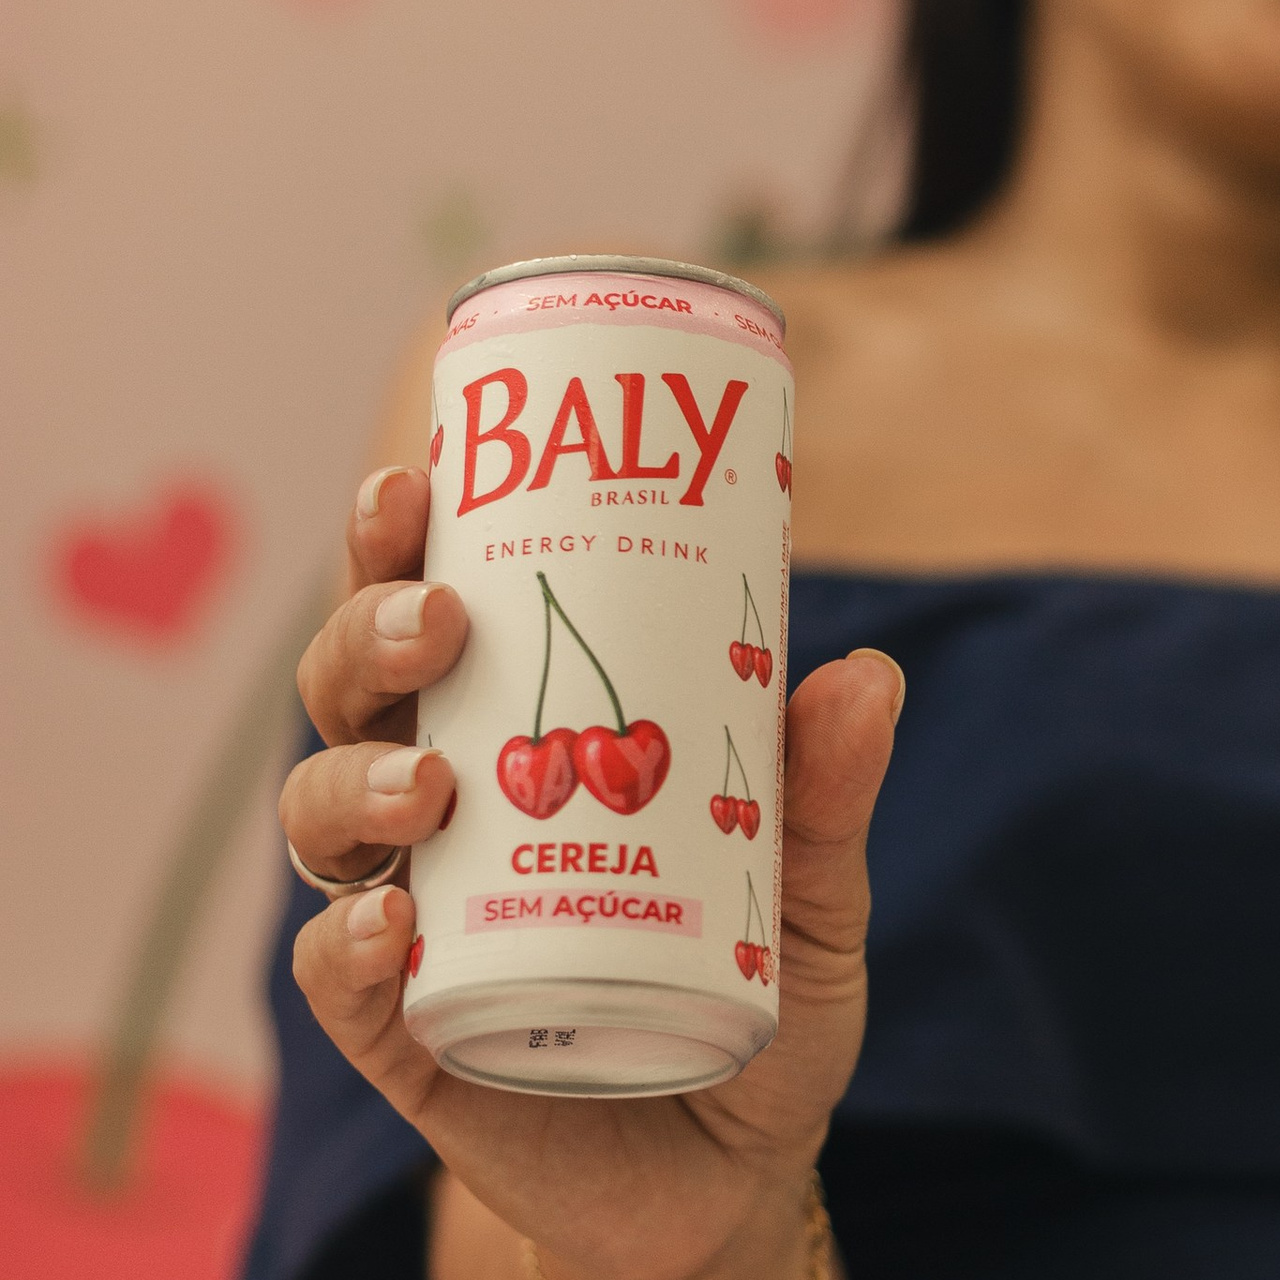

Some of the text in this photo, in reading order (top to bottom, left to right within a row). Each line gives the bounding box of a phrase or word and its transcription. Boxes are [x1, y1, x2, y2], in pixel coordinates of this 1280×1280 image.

[526, 289, 693, 315] SEM AÇÚCAR
[734, 314, 771, 342] SEM
[457, 367, 749, 518] BALY
[590, 489, 670, 507] BRASIL
[485, 535, 709, 564] ENERGY DRINK
[511, 842, 661, 878] CEREJA
[484, 890, 684, 925] SEM AÇÚCAR
